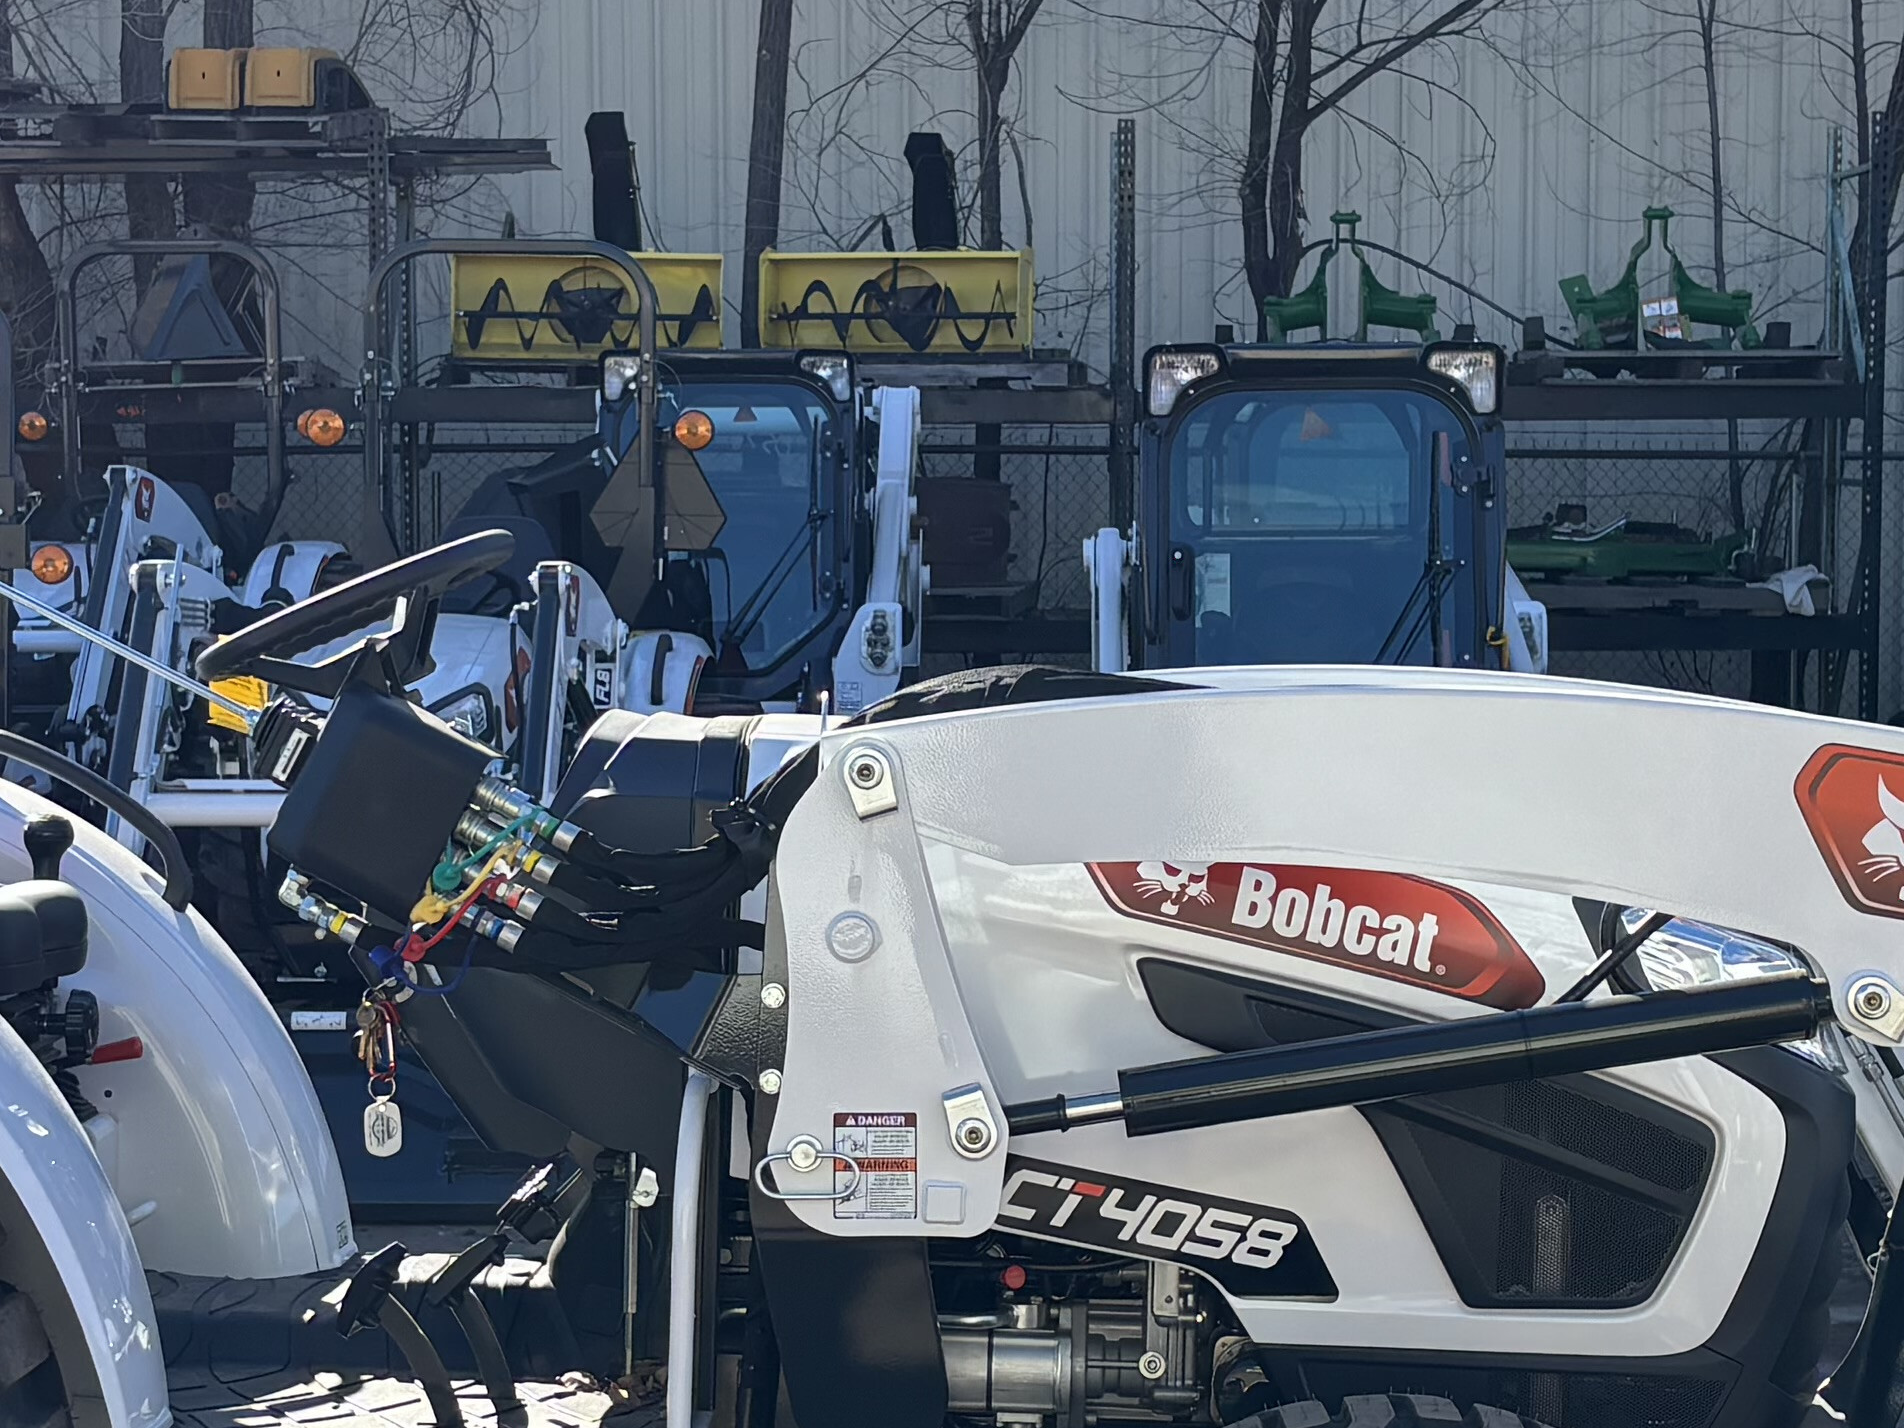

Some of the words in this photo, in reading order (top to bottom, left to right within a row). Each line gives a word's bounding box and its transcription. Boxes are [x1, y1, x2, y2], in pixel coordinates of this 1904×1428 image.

[1231, 866, 1440, 972] Bobcat
[857, 1115, 906, 1126] DANGER
[998, 1168, 1298, 1269] CT4058
